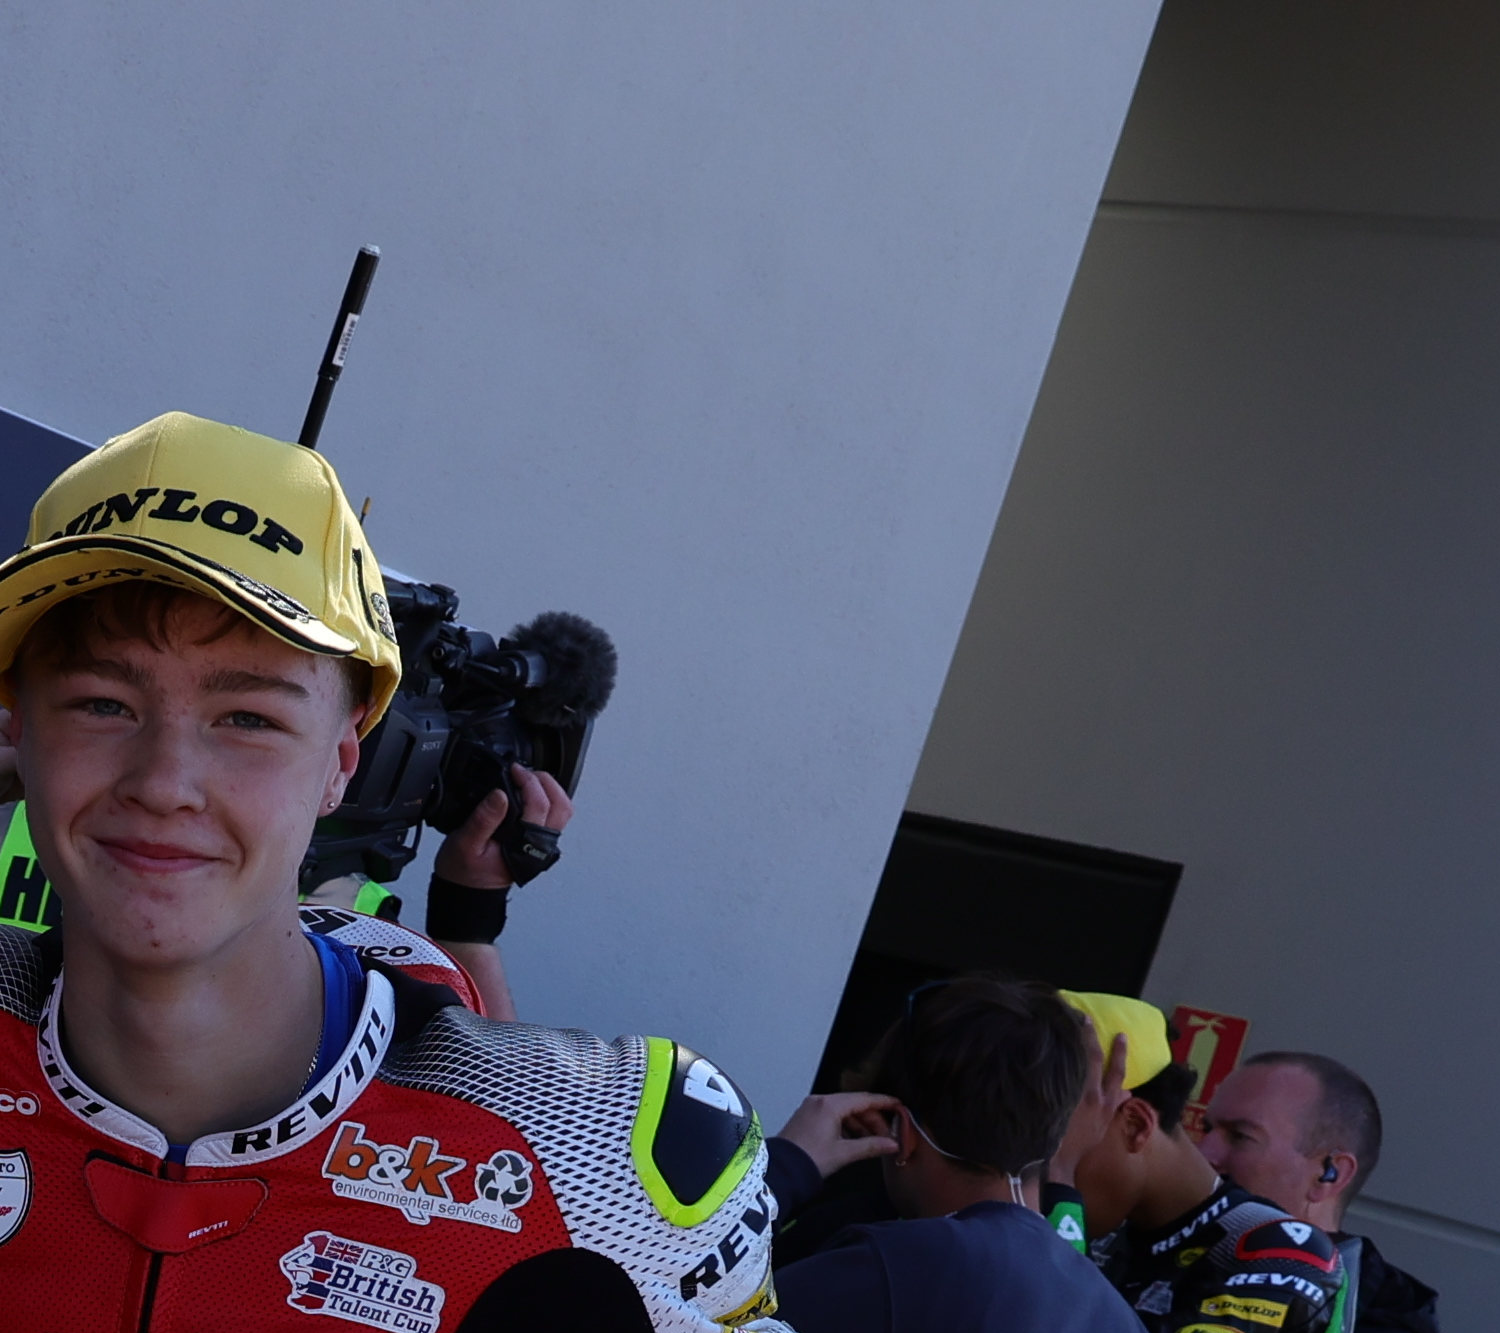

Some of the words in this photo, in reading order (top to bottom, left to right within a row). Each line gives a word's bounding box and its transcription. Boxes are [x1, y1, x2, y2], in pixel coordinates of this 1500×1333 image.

[327, 1125, 457, 1199] b&k
[335, 1180, 434, 1212] environmental
[438, 1201, 499, 1226] services
[361, 1250, 413, 1278] R&G
[328, 1263, 437, 1314] British
[328, 1294, 391, 1324] Talent
[1222, 1300, 1282, 1318] DUNLOP
